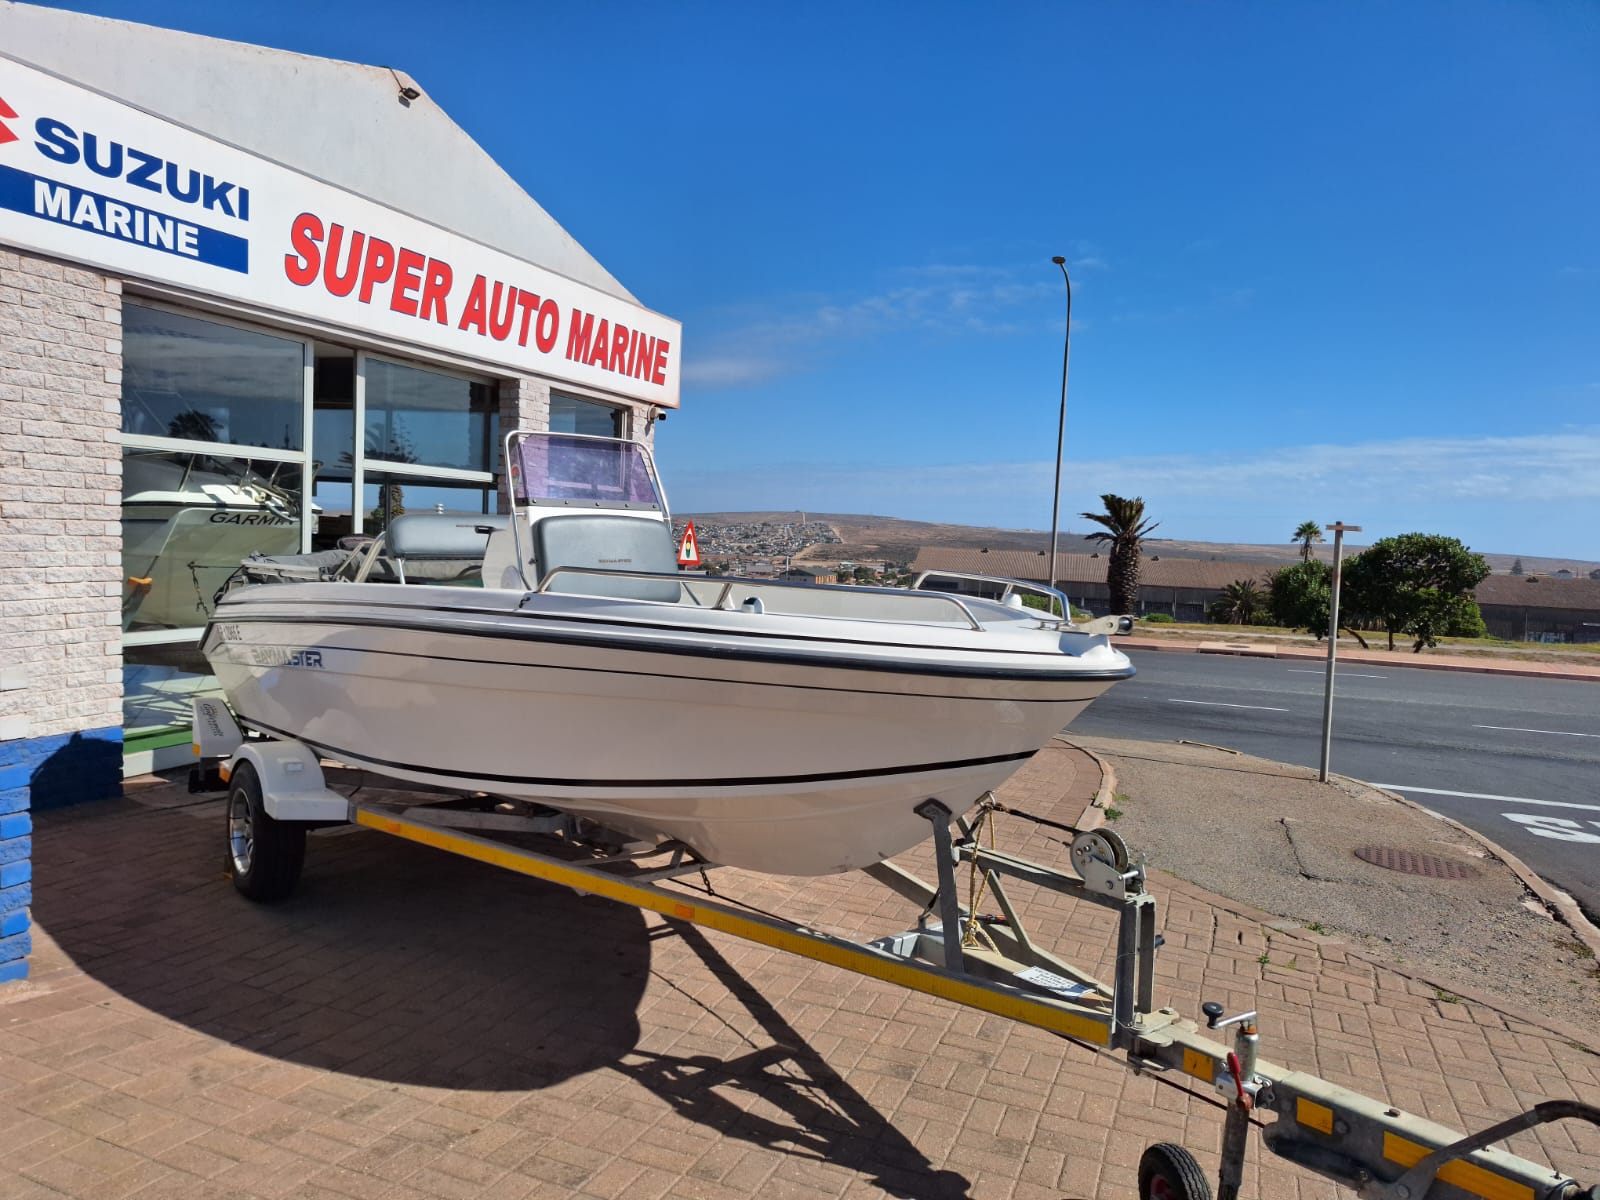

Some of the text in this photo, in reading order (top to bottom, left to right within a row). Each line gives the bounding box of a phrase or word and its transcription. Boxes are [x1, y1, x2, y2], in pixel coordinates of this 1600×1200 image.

[34, 117, 249, 221] SUZUKI
[34, 180, 199, 257] MARINE
[285, 213, 670, 386] SUPER AUTO MARINE
